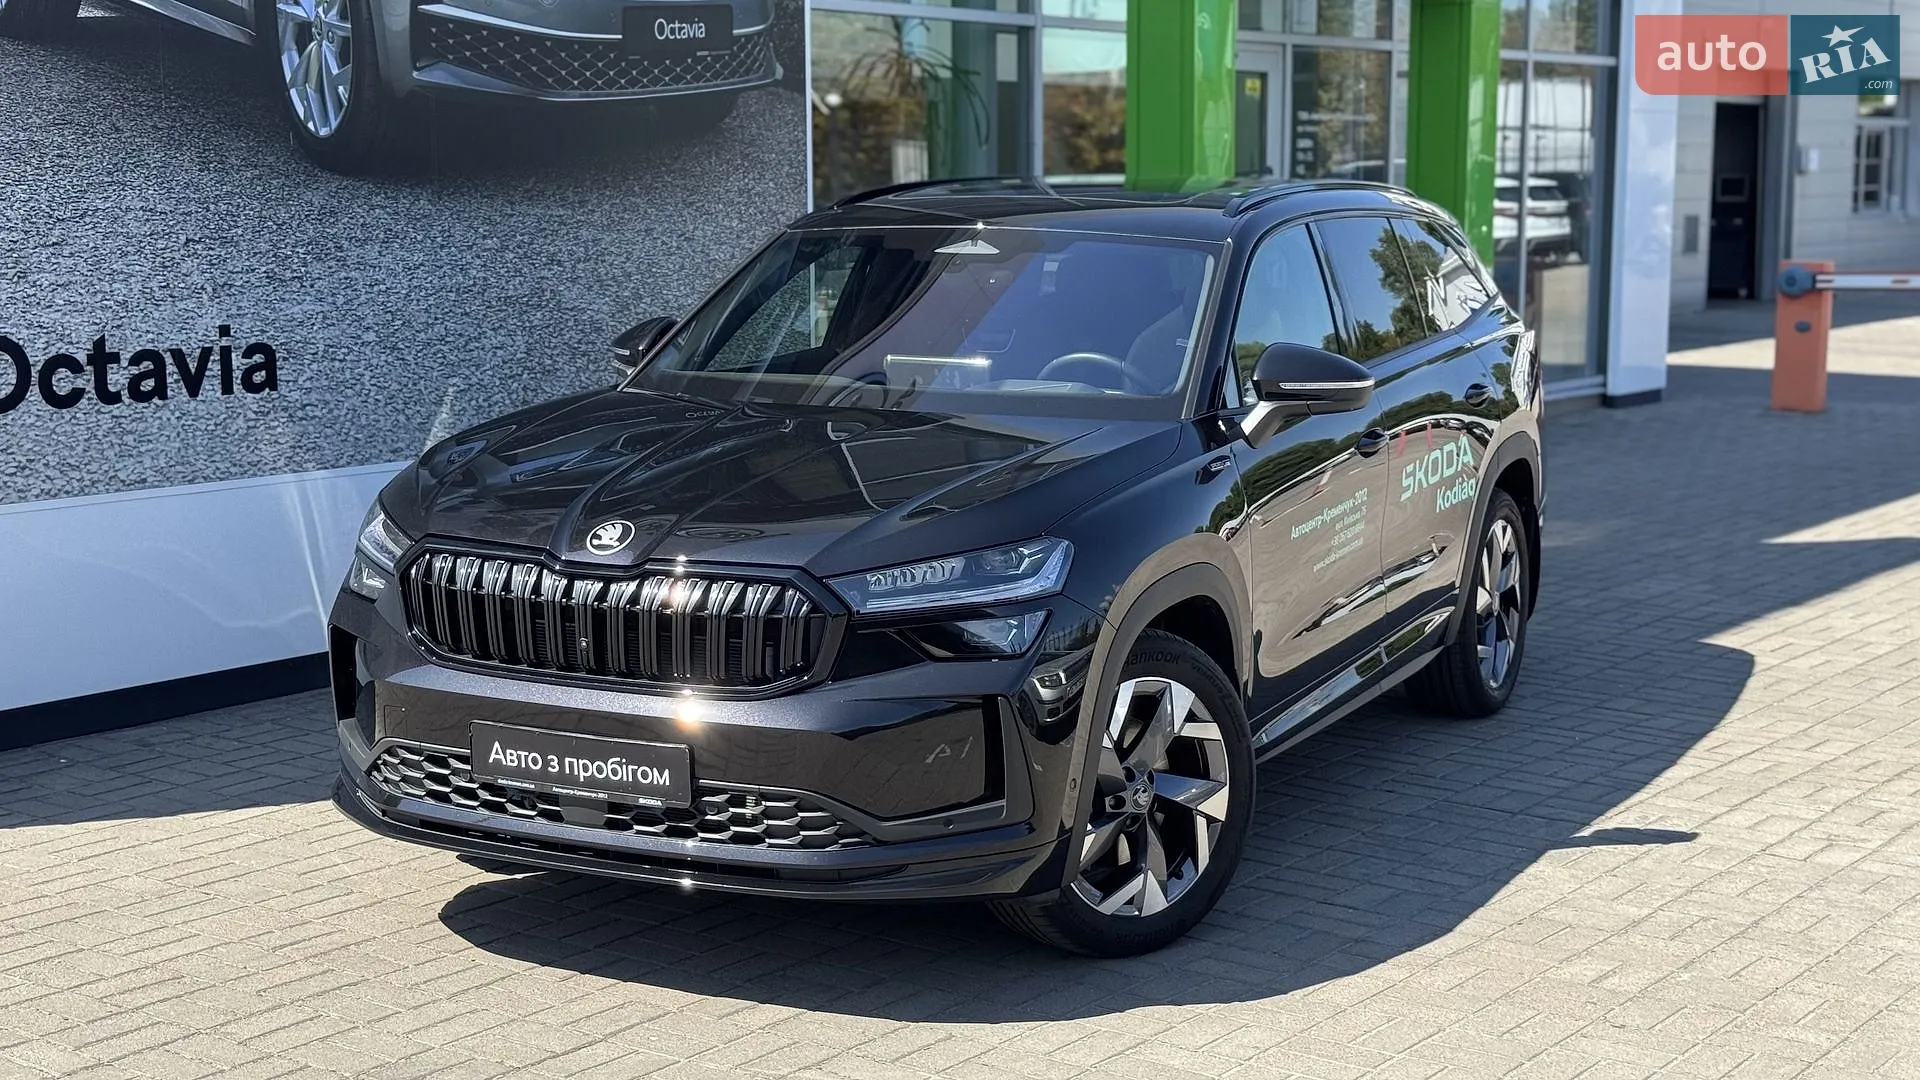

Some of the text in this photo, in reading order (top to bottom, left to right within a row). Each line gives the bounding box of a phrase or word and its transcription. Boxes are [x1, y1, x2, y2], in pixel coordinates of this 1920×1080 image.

[654, 18, 706, 40] Octavia
[488, 741, 671, 787] Авто з пробігом
